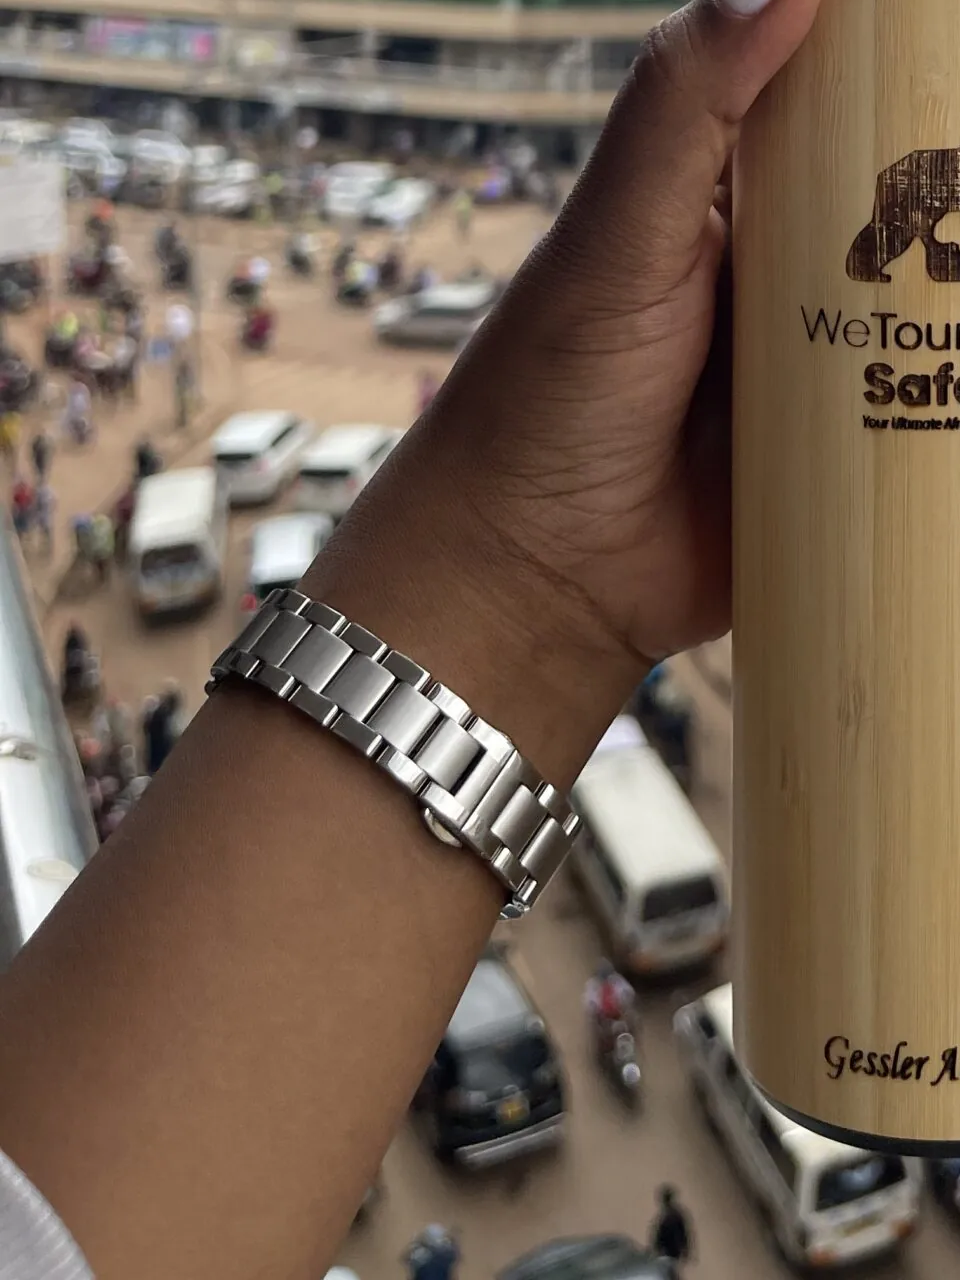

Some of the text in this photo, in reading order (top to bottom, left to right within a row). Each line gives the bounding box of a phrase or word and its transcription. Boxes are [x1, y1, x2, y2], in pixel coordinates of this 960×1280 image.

[862, 414, 889, 429] Your
[891, 415, 942, 430] Ultimate
[824, 1035, 929, 1080] Gessler
